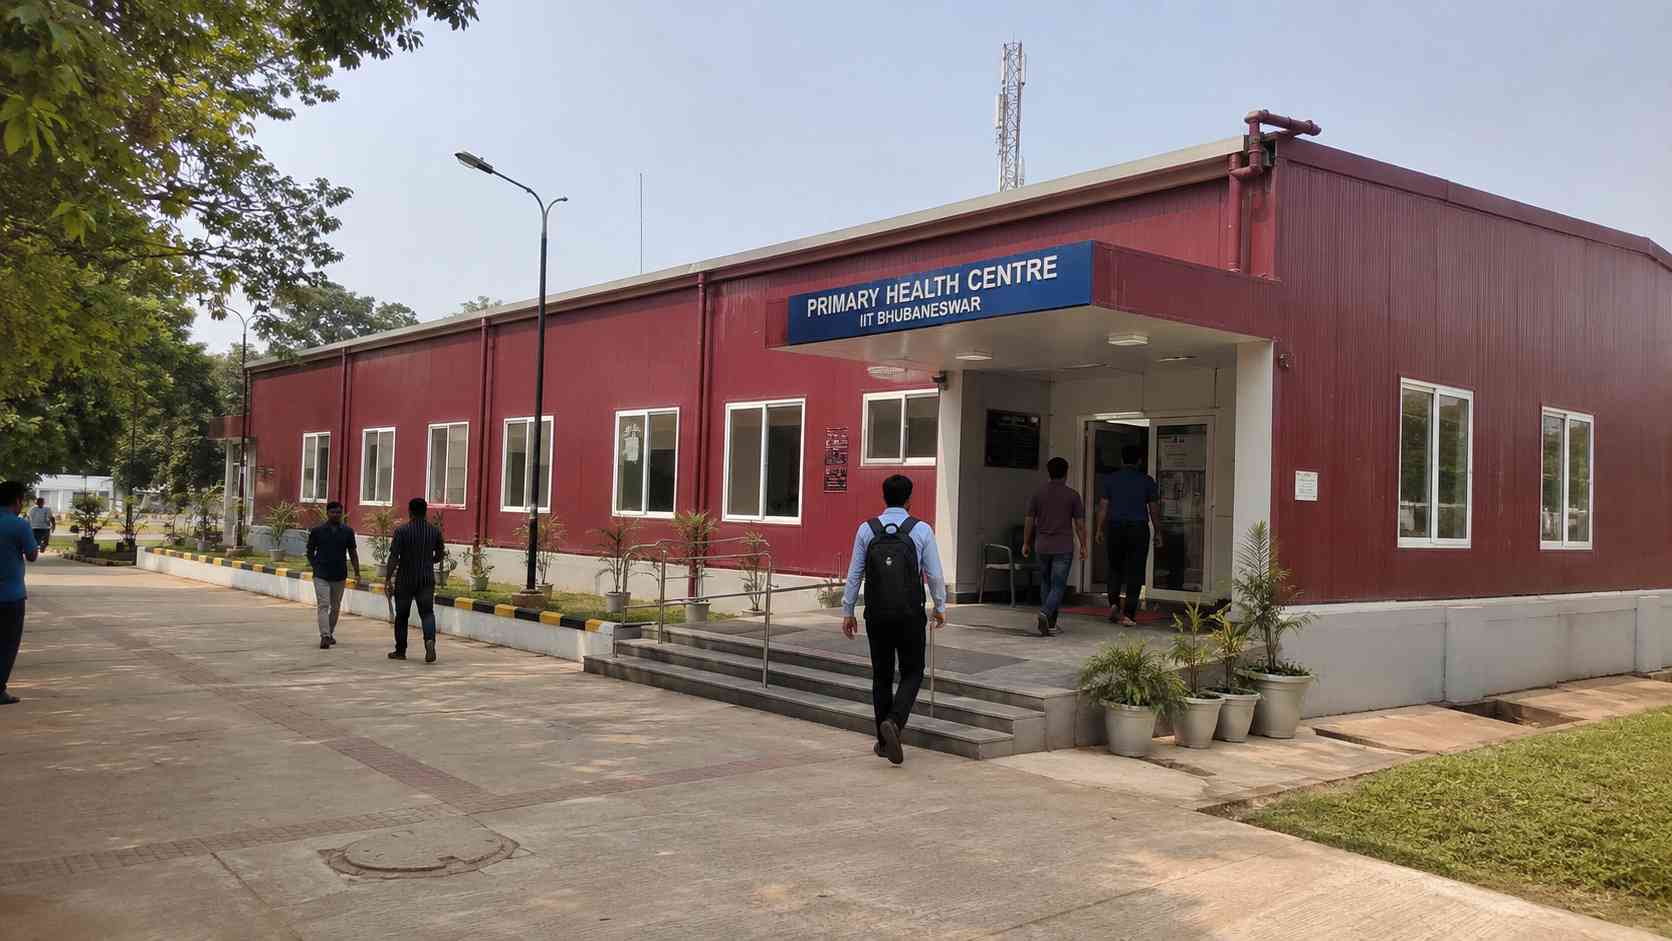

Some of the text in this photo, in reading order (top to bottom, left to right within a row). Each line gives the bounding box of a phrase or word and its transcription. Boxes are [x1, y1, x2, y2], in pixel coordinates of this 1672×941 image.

[807, 255, 1057, 317] PRIMARY HEALTH CENTRE
[860, 296, 980, 328] IIT BHUBANESWAR
